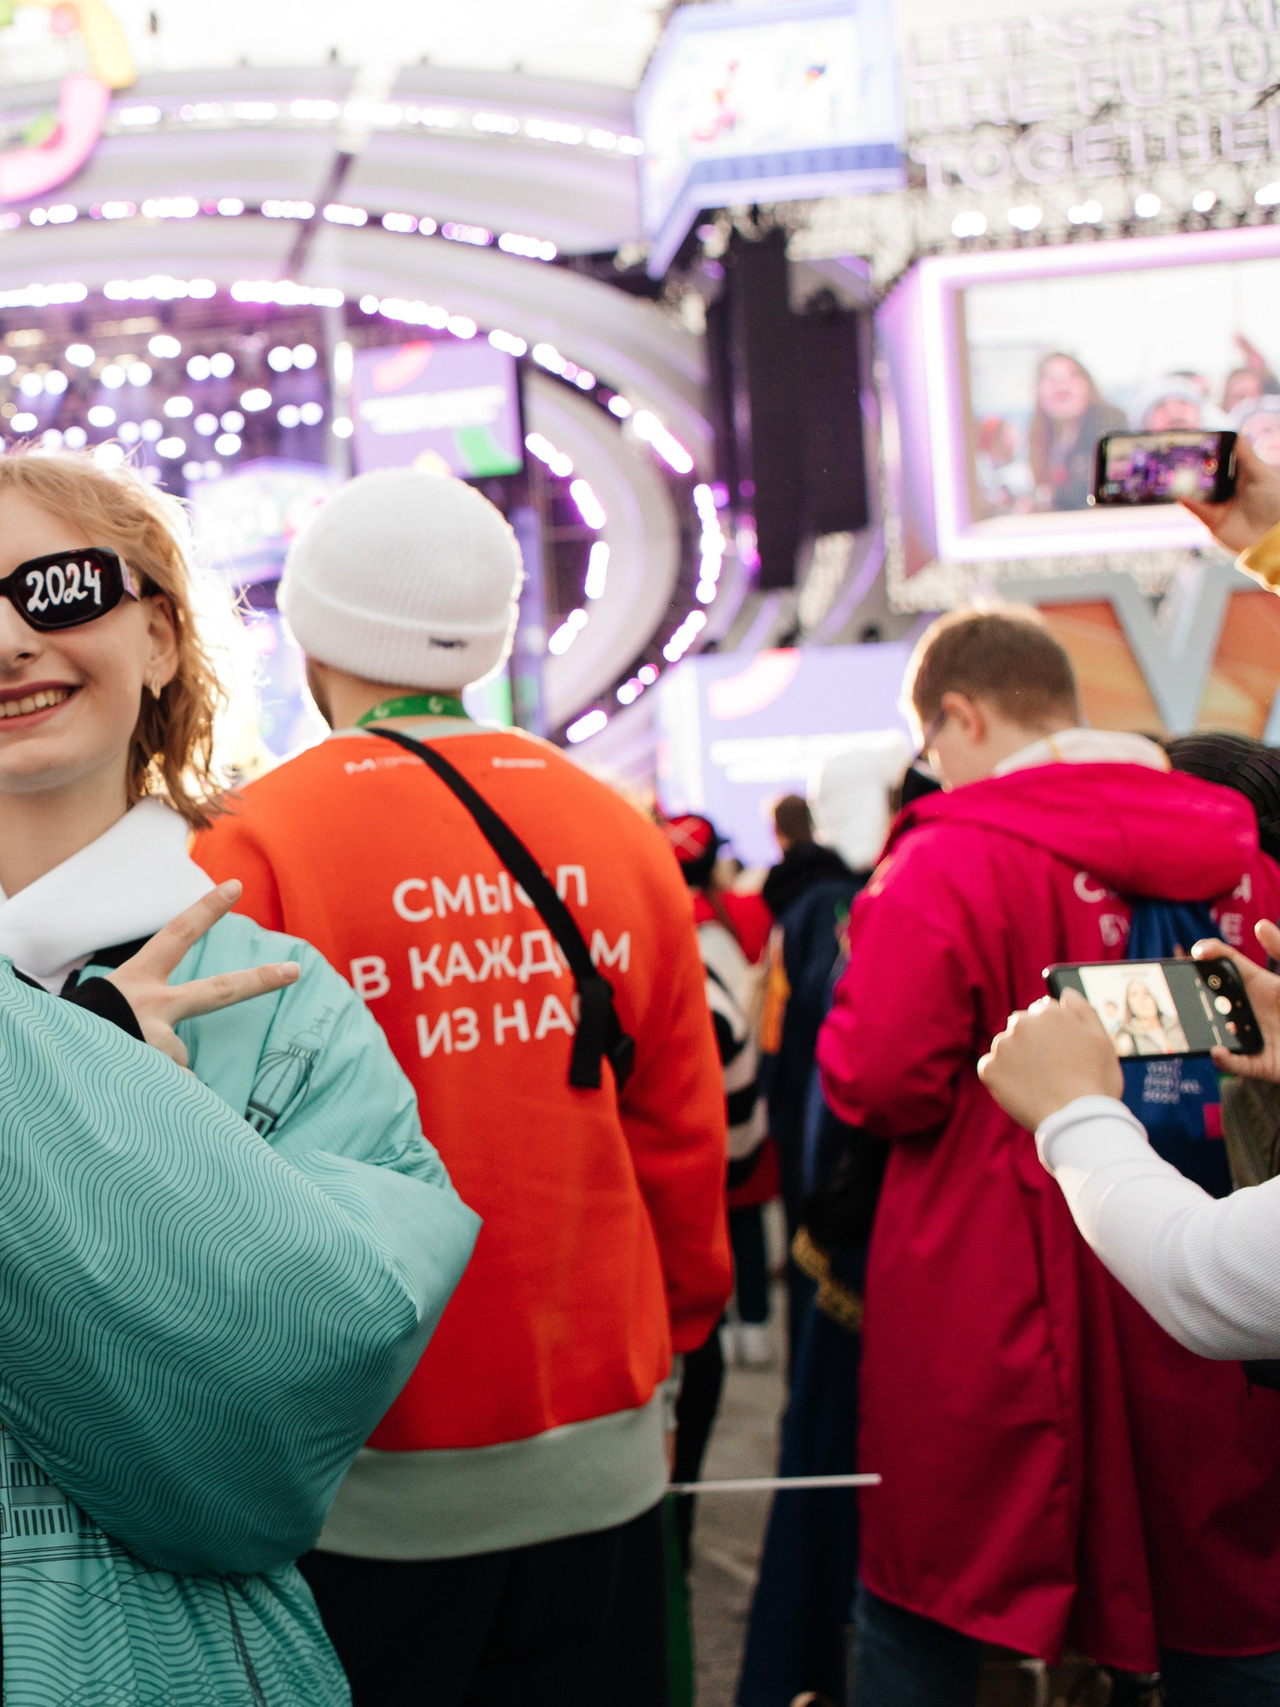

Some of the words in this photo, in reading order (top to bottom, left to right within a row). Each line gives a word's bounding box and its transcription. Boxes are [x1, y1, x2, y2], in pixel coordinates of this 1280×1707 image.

[25, 560, 102, 613] 2024
[350, 955, 391, 1001] В
[407, 929, 631, 990] КАЖДМ
[415, 1006, 481, 1059] ИЗ
[492, 994, 582, 1046] НА
